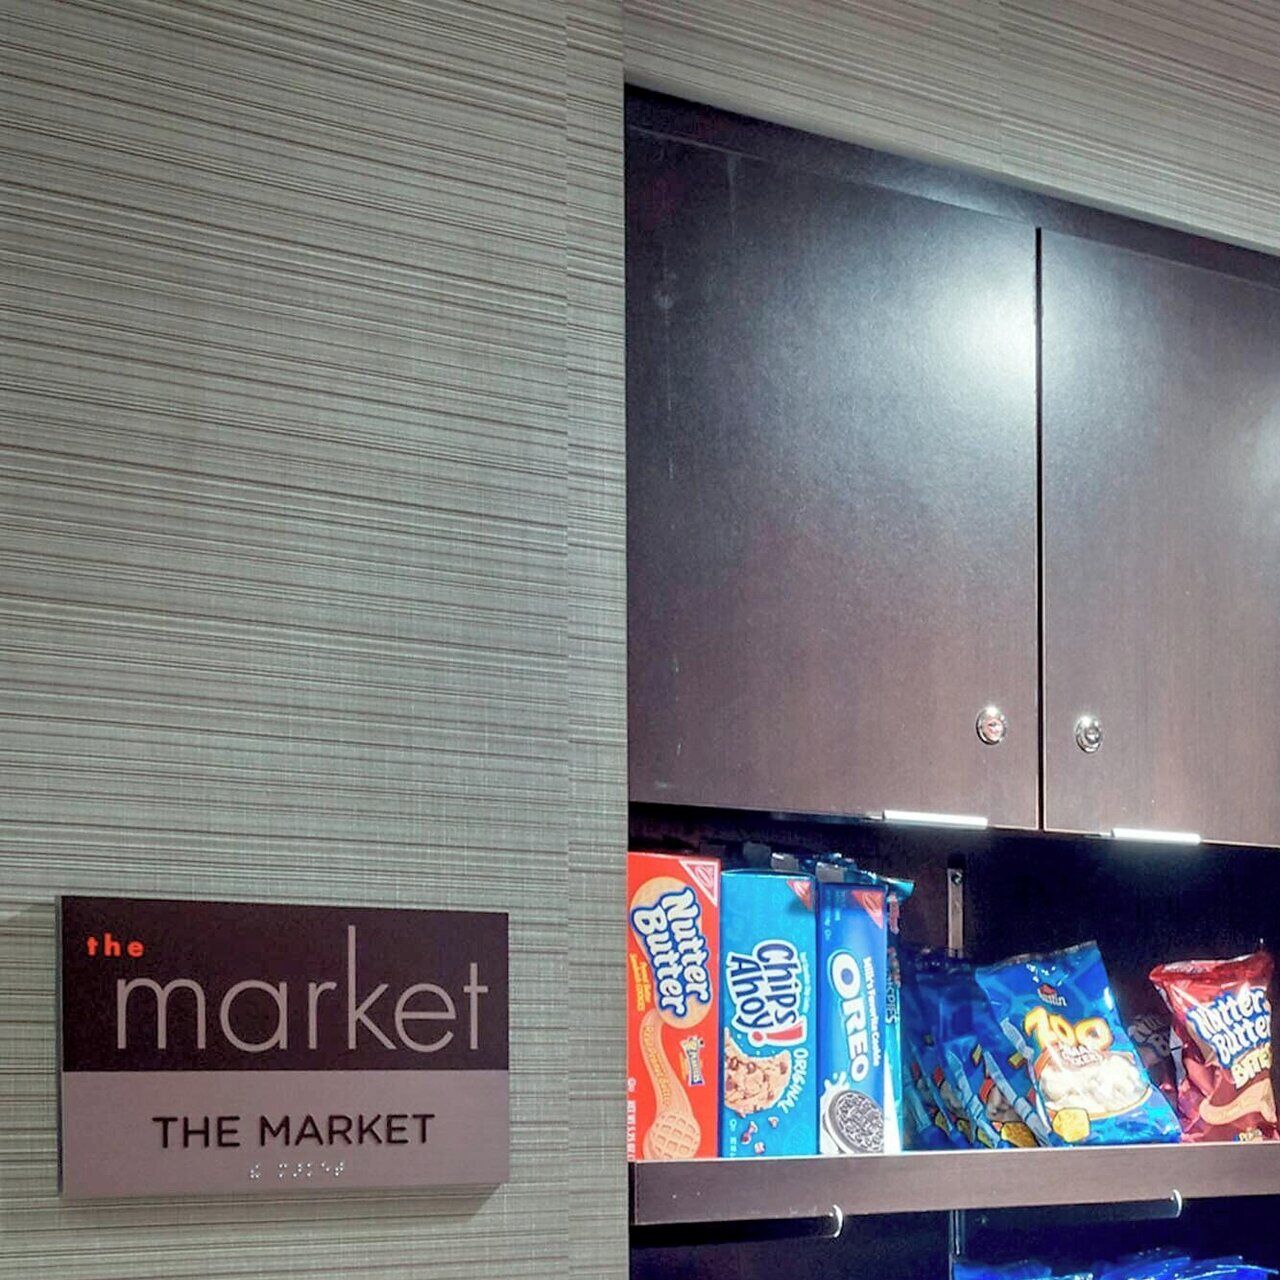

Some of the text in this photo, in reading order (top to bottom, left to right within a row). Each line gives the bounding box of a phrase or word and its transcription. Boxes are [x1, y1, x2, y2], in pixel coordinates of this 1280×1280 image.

[87, 934, 145, 959] the
[633, 905, 686, 1015] Butter
[660, 887, 711, 1002] Nutter
[116, 925, 489, 1054] market
[757, 942, 800, 1026] Chips
[831, 951, 870, 1082] OREO
[1188, 984, 1265, 1038] Nutter
[1024, 1006, 1114, 1051] ZOO
[779, 1048, 809, 1113] ORIGINAL
[152, 1113, 436, 1149] THE MARKET
